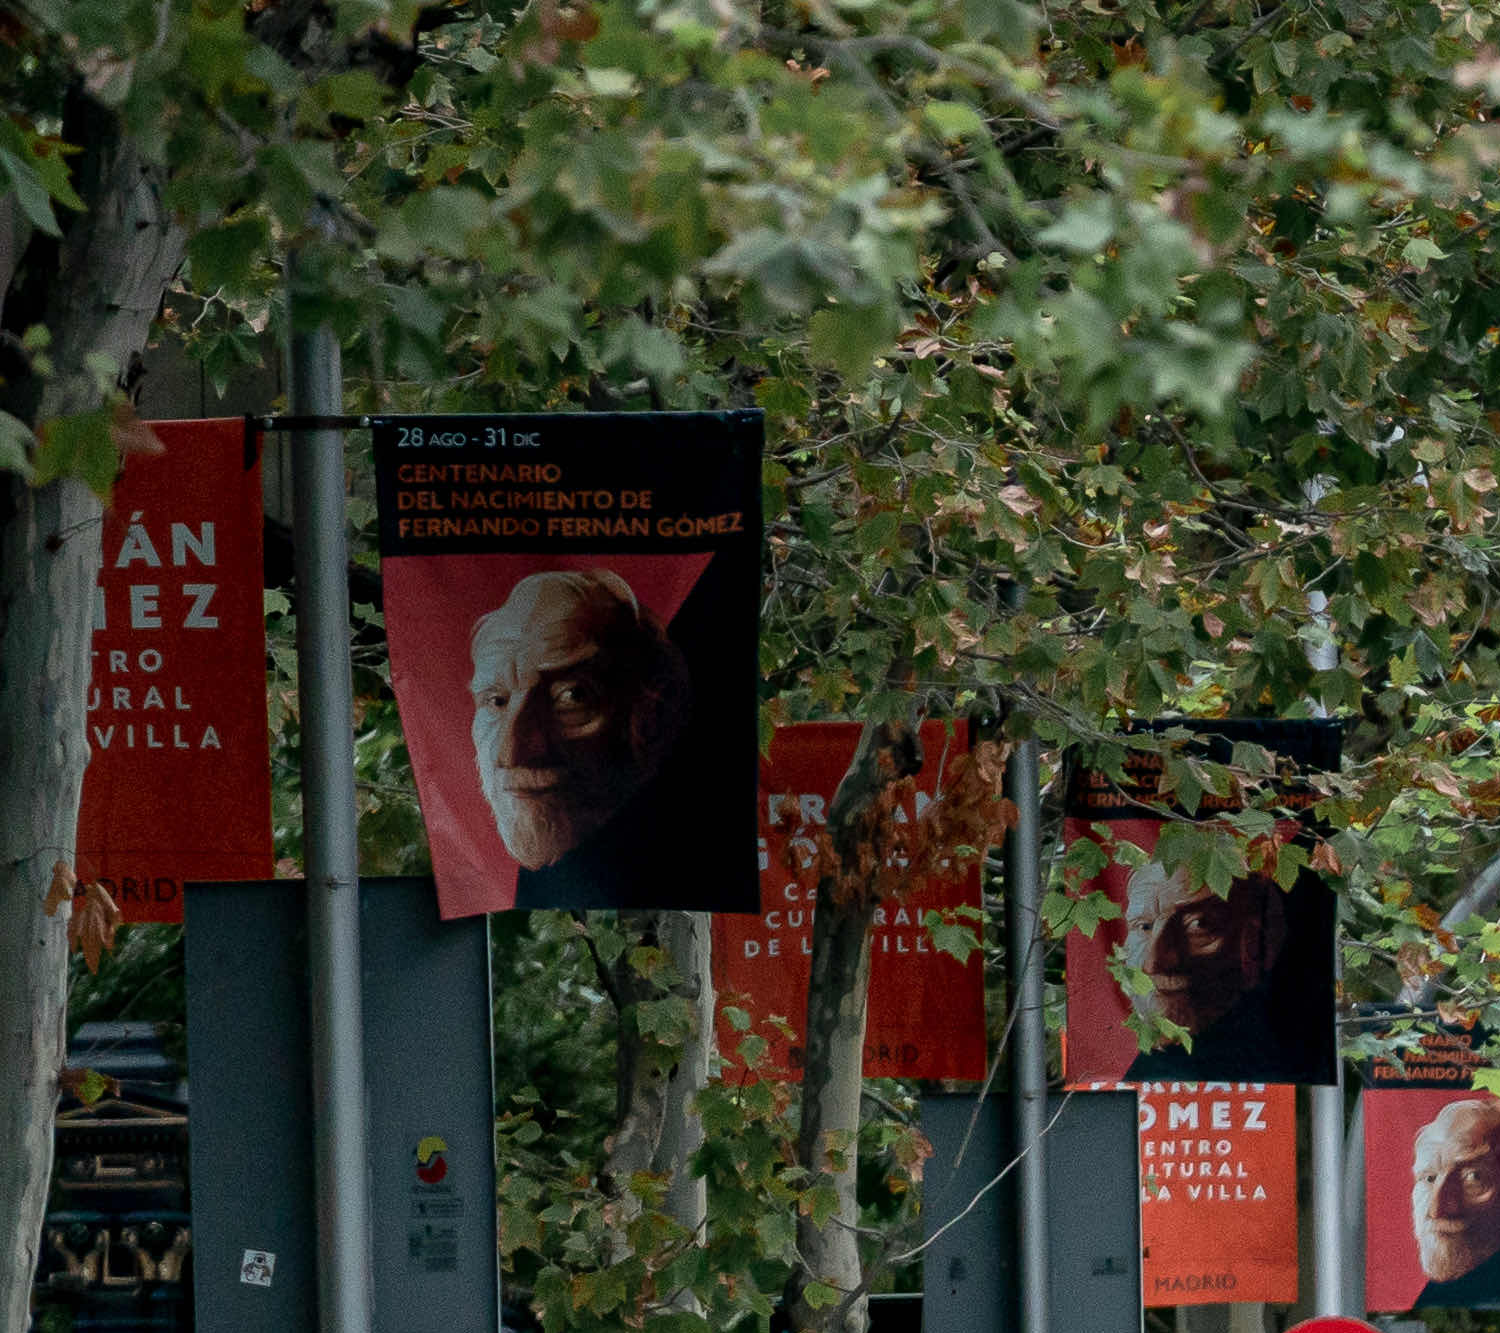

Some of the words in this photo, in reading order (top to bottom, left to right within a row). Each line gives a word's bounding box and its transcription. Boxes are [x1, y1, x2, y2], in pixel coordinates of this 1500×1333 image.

[398, 428, 424, 447] 28
[429, 433, 466, 447] AGO
[484, 428, 507, 447] 31
[513, 433, 541, 447] DIC
[398, 463, 562, 484] CENTENARIO
[399, 491, 445, 511] DEL
[451, 491, 614, 511] NACIMIENTO
[621, 490, 653, 510] DE
[399, 518, 540, 538] FERNANDO
[548, 514, 650, 537] FERNÁN
[657, 512, 744, 537] GÓMEZ
[94, 725, 222, 750] VILLA
[744, 940, 780, 958] DE
[1138, 1094, 1268, 1131] ÓMEZ
[1144, 1140, 1232, 1157] ENTRO
[1141, 1161, 1249, 1179] LTURAL
[1187, 1183, 1267, 1202] VILLA
[1153, 1271, 1238, 1292] MADRID
